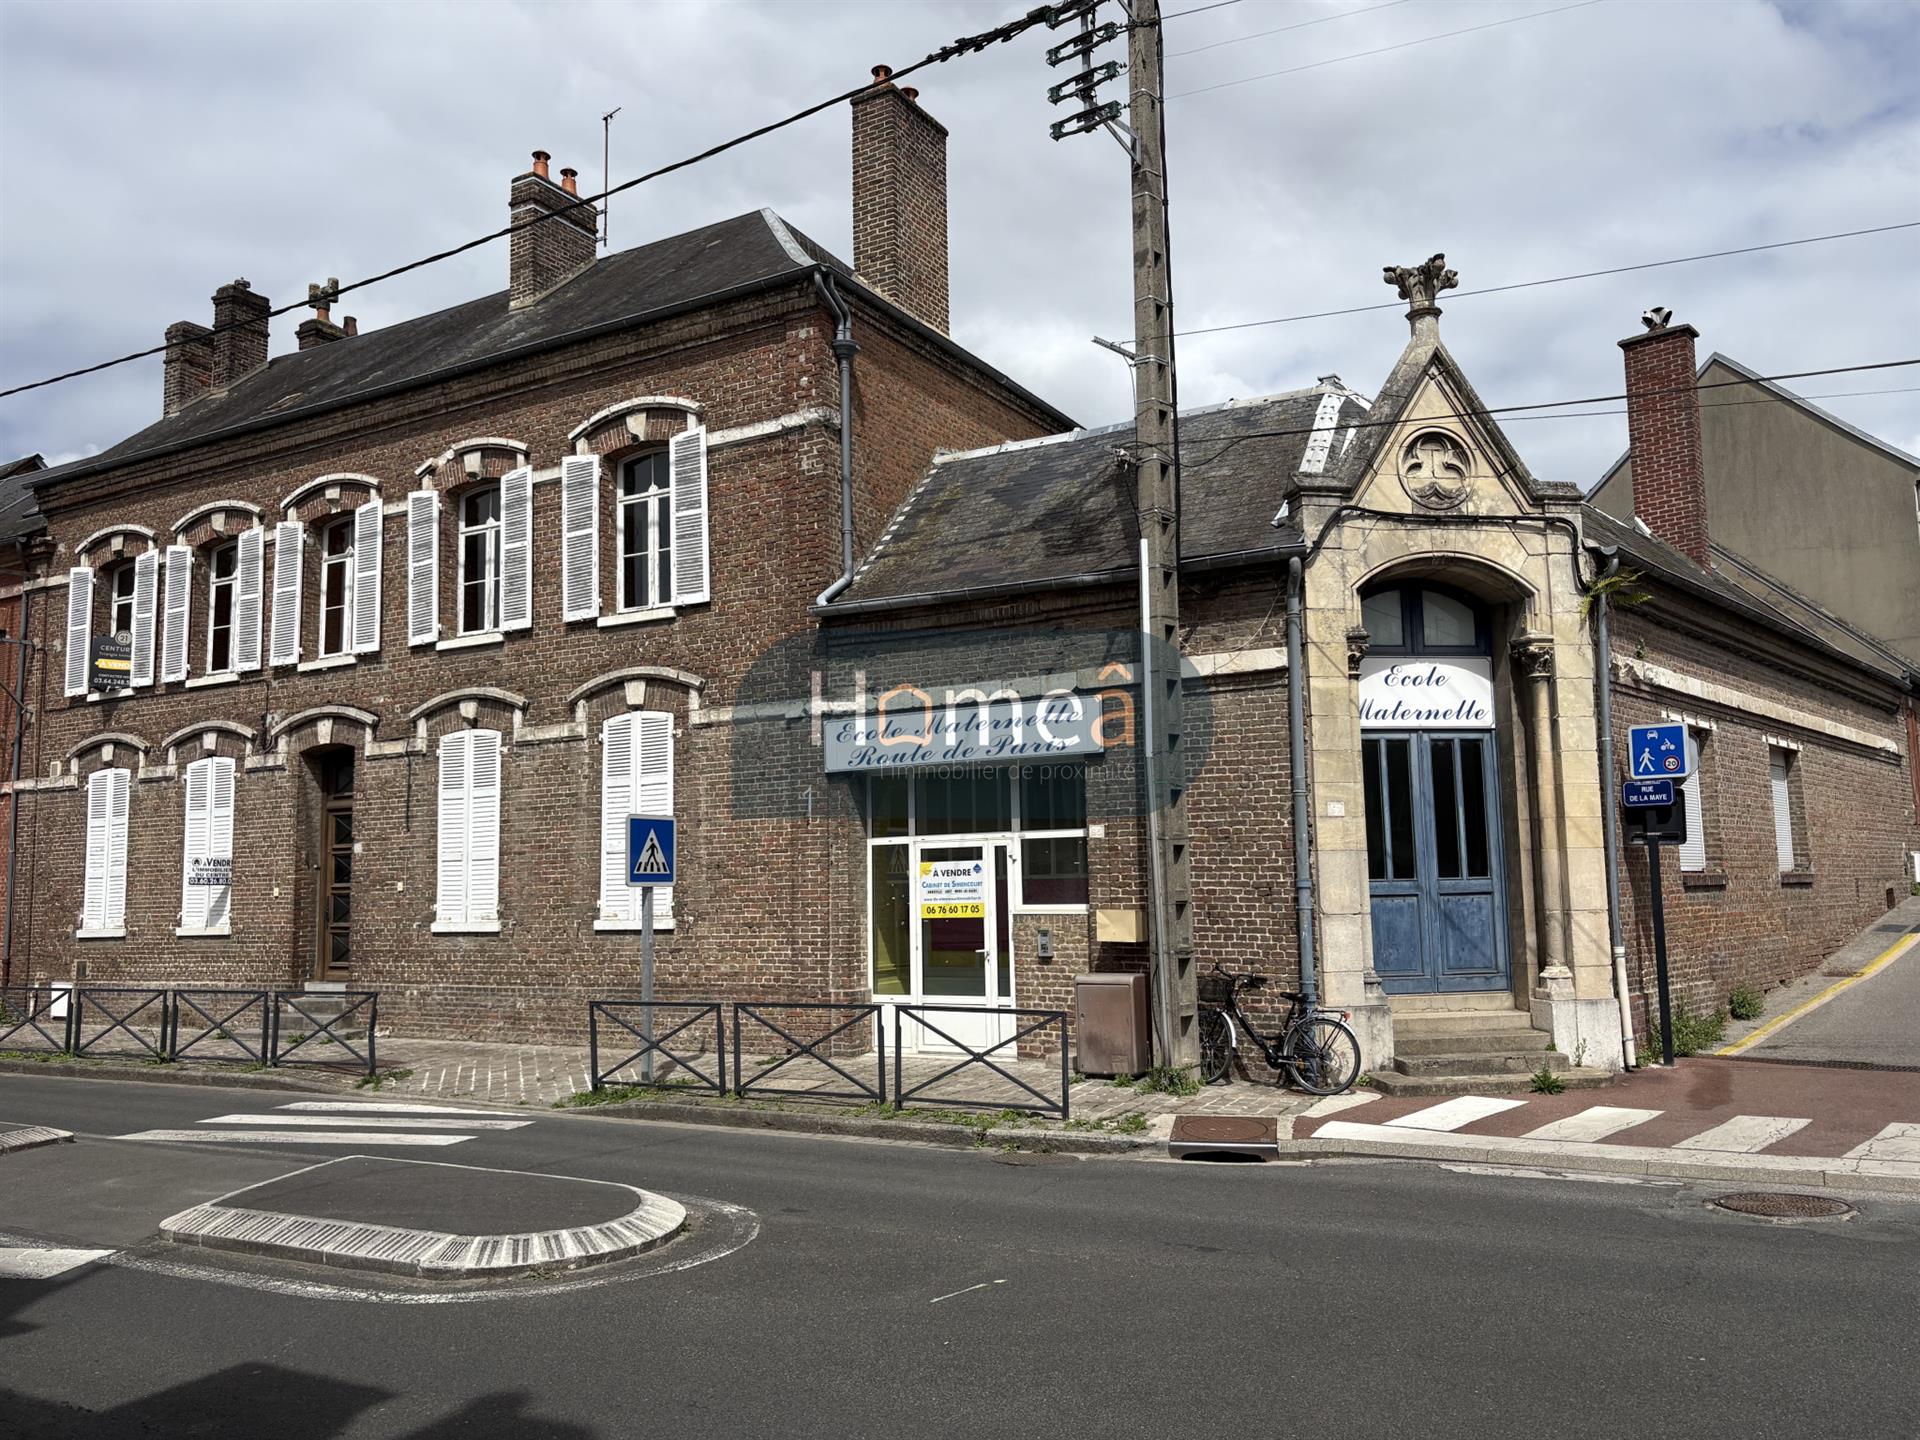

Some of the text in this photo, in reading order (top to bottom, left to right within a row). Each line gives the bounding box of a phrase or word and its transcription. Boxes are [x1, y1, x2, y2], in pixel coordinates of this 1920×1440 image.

[1384, 664, 1450, 687] Ecole
[836, 702, 1086, 744] Ecole Maternelle
[847, 734, 1070, 767] Route de Paris
[206, 857, 231, 867] VENDR
[941, 868, 971, 877] VENDRE
[926, 904, 980, 914] 06 76 60 17 05
